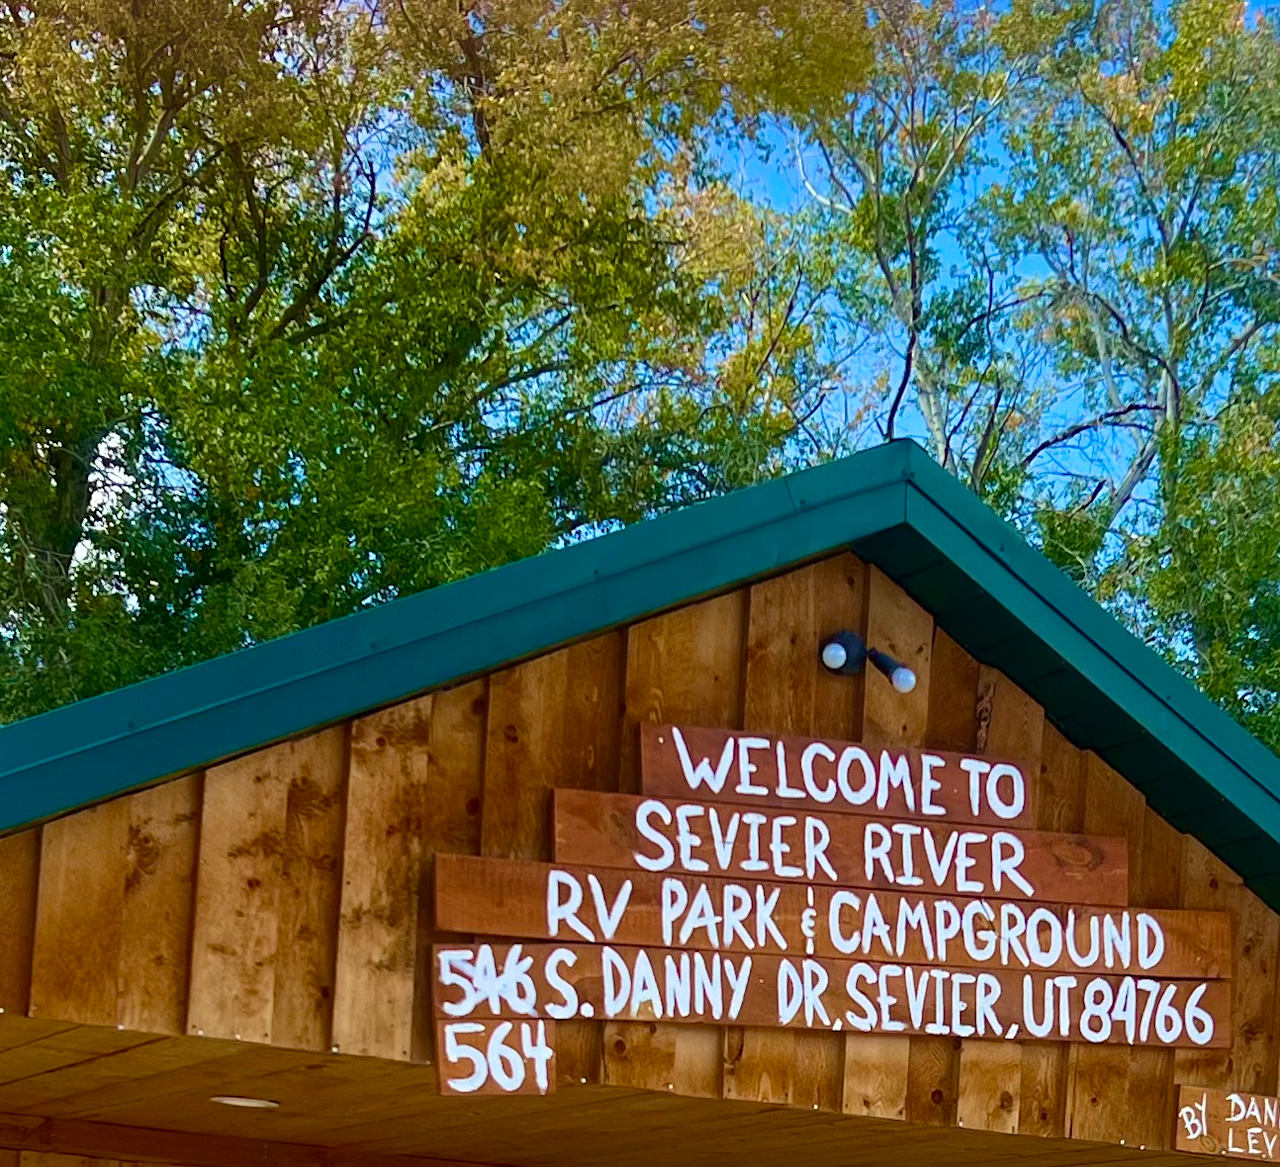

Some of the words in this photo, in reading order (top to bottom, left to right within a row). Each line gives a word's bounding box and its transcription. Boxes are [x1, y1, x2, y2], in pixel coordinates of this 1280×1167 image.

[672, 726, 947, 816] WELCOME
[960, 758, 1025, 819] TO
[633, 800, 838, 882] SEVIER
[864, 823, 1035, 898] RIVER
[547, 869, 632, 943] RV
[662, 877, 787, 950] PARK
[801, 886, 817, 955] &
[829, 890, 1165, 970] CAMPGROUND
[544, 948, 594, 1019] S.
[602, 946, 752, 1021] DANNY
[845, 962, 1019, 1040] SEVIER,
[1022, 974, 1077, 1037] UT
[1079, 975, 1215, 1045] 84766
[444, 1019, 553, 1095] 564
[1178, 1092, 1208, 1139] BY
